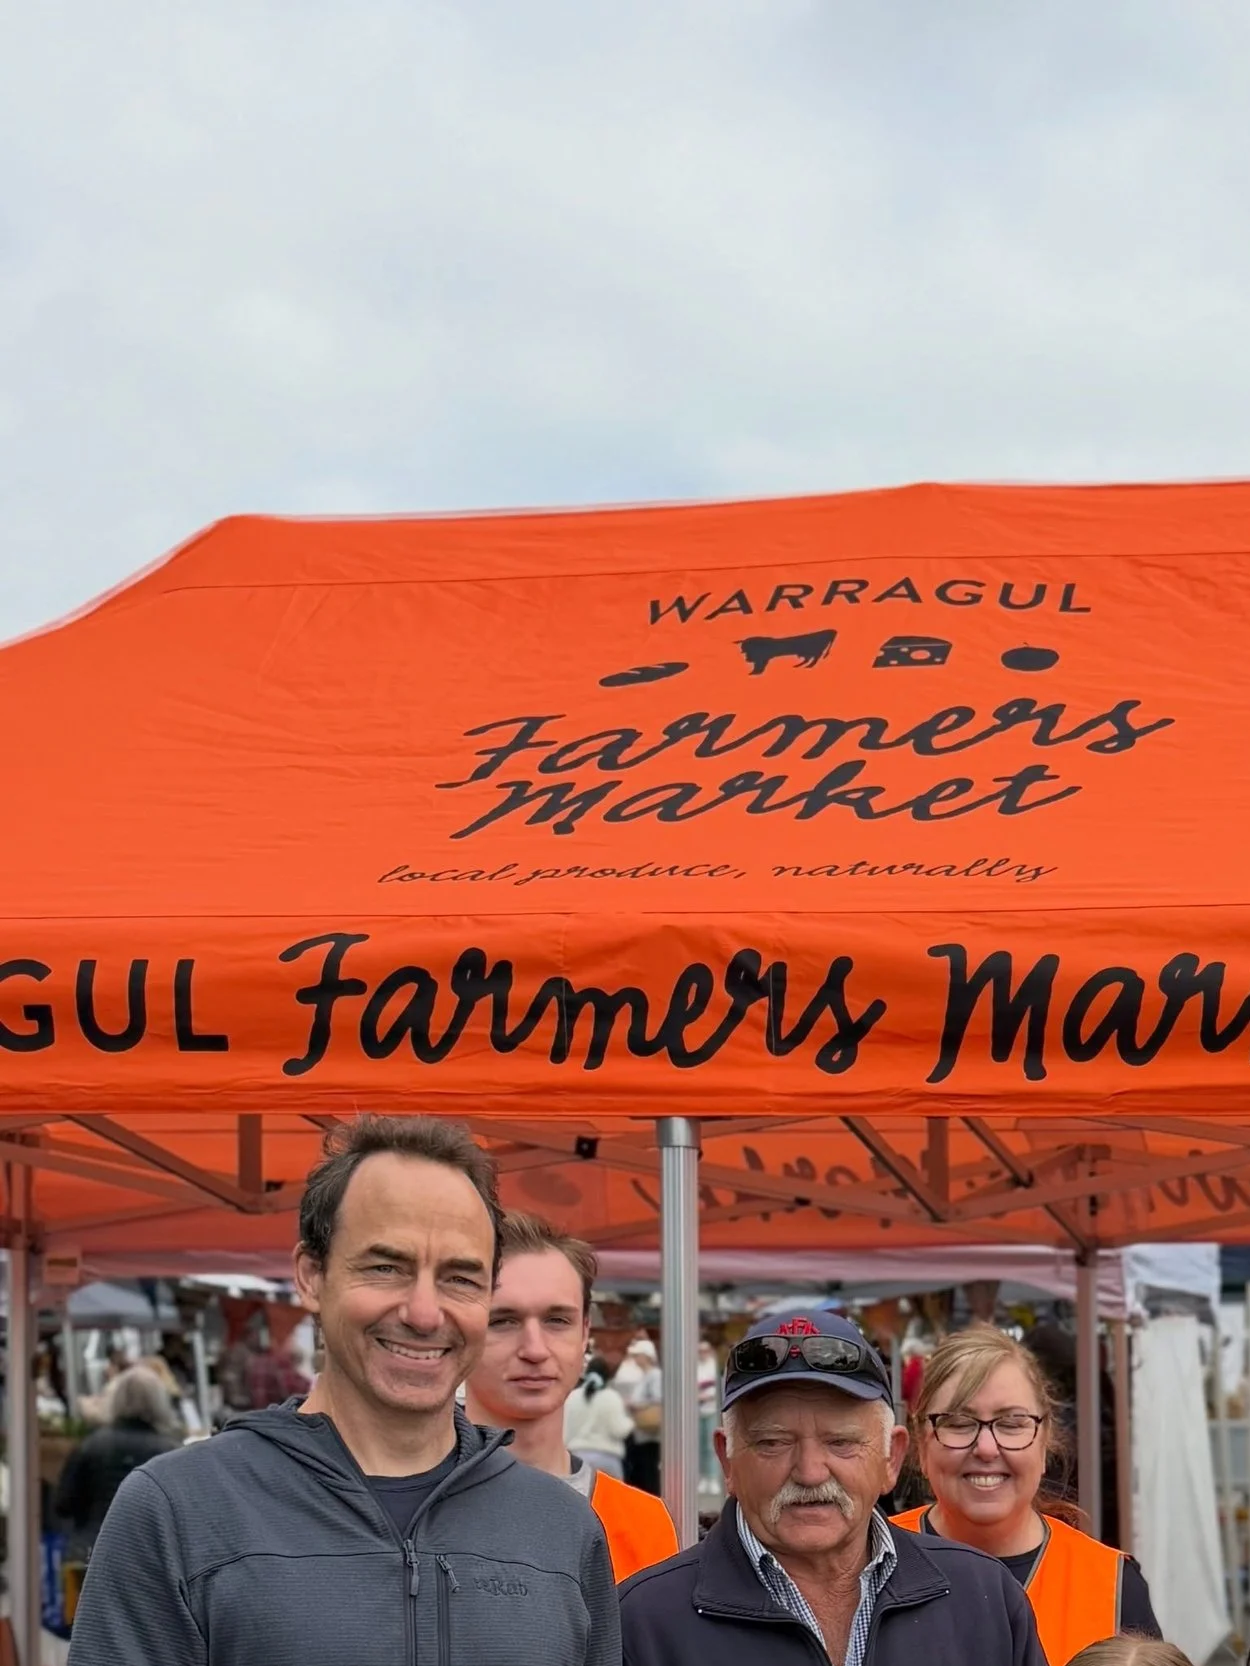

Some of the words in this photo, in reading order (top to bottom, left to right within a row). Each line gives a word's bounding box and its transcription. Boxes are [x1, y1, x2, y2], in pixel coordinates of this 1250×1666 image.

[650, 577, 1091, 625] WARRAGUL
[436, 697, 1175, 789] Farmers
[450, 763, 1084, 840] Market
[377, 863, 516, 883] local
[514, 861, 748, 887] produce,
[771, 857, 1060, 883] naturally
[0, 958, 230, 1053] GUL
[279, 932, 888, 1077] Farmers
